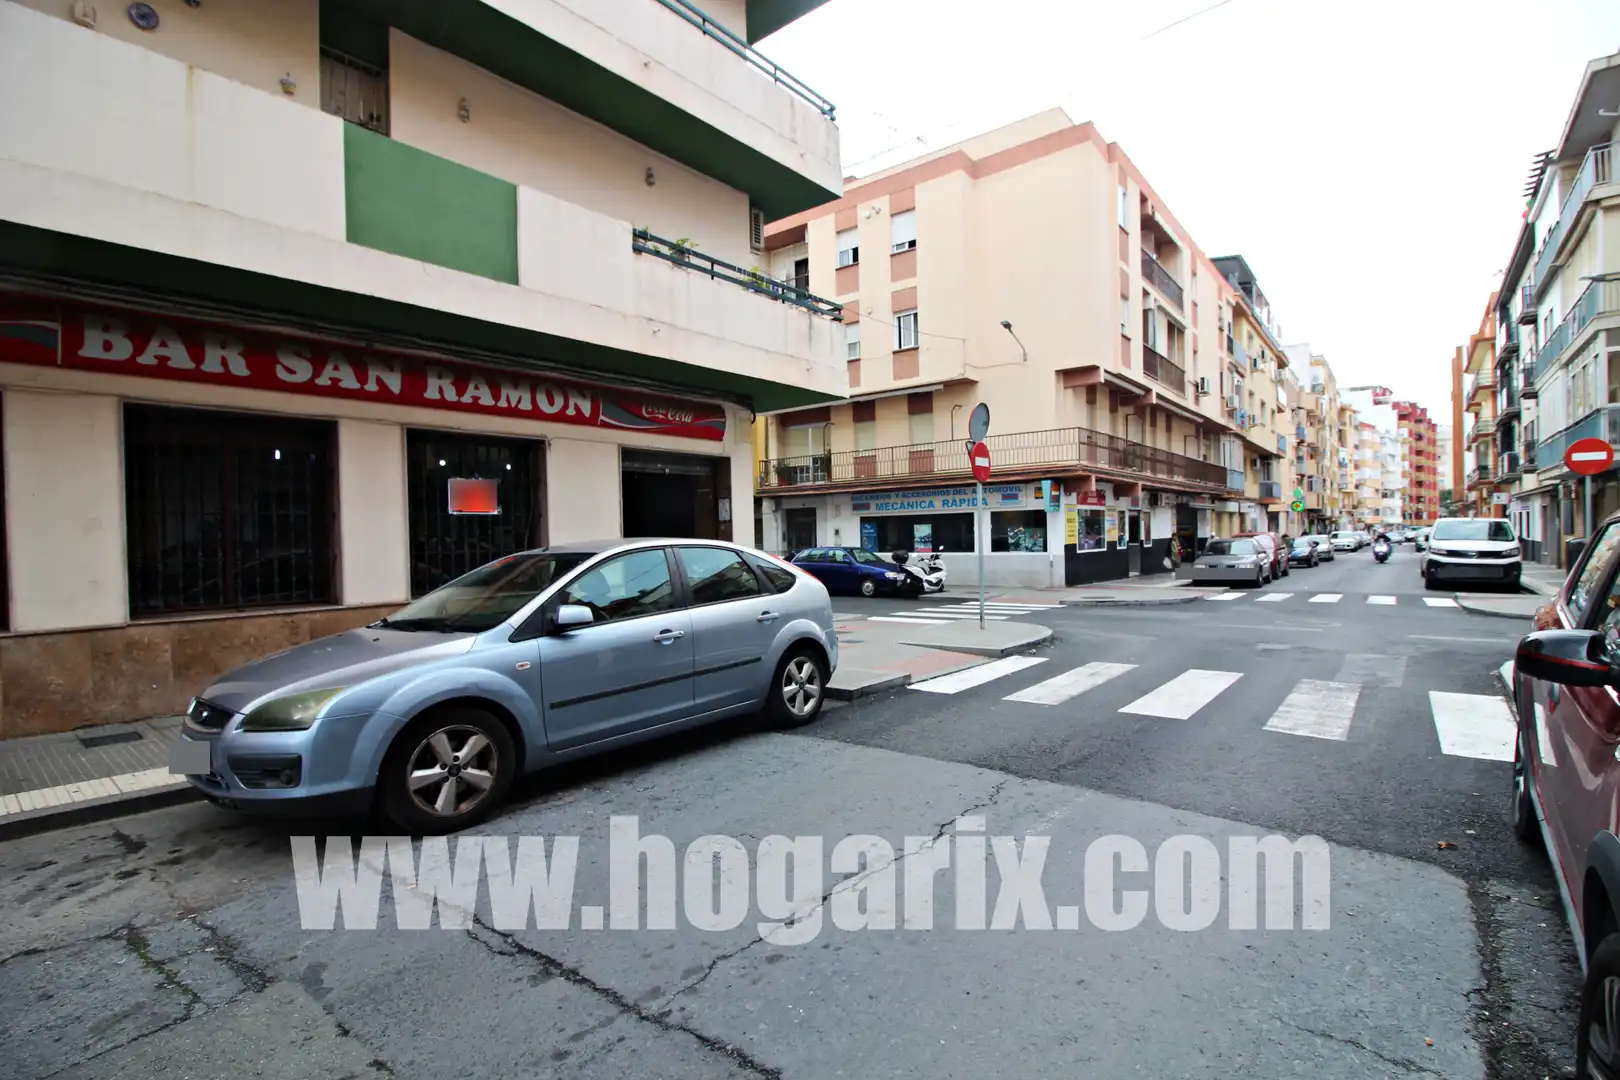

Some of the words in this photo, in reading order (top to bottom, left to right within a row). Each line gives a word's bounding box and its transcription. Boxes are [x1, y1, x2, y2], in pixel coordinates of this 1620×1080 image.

[77, 312, 251, 377] BAR
[274, 343, 403, 396] SAN
[423, 364, 594, 418] RAMON
[952, 487, 968, 496] DEL
[971, 485, 1023, 495] ATOMOVIL
